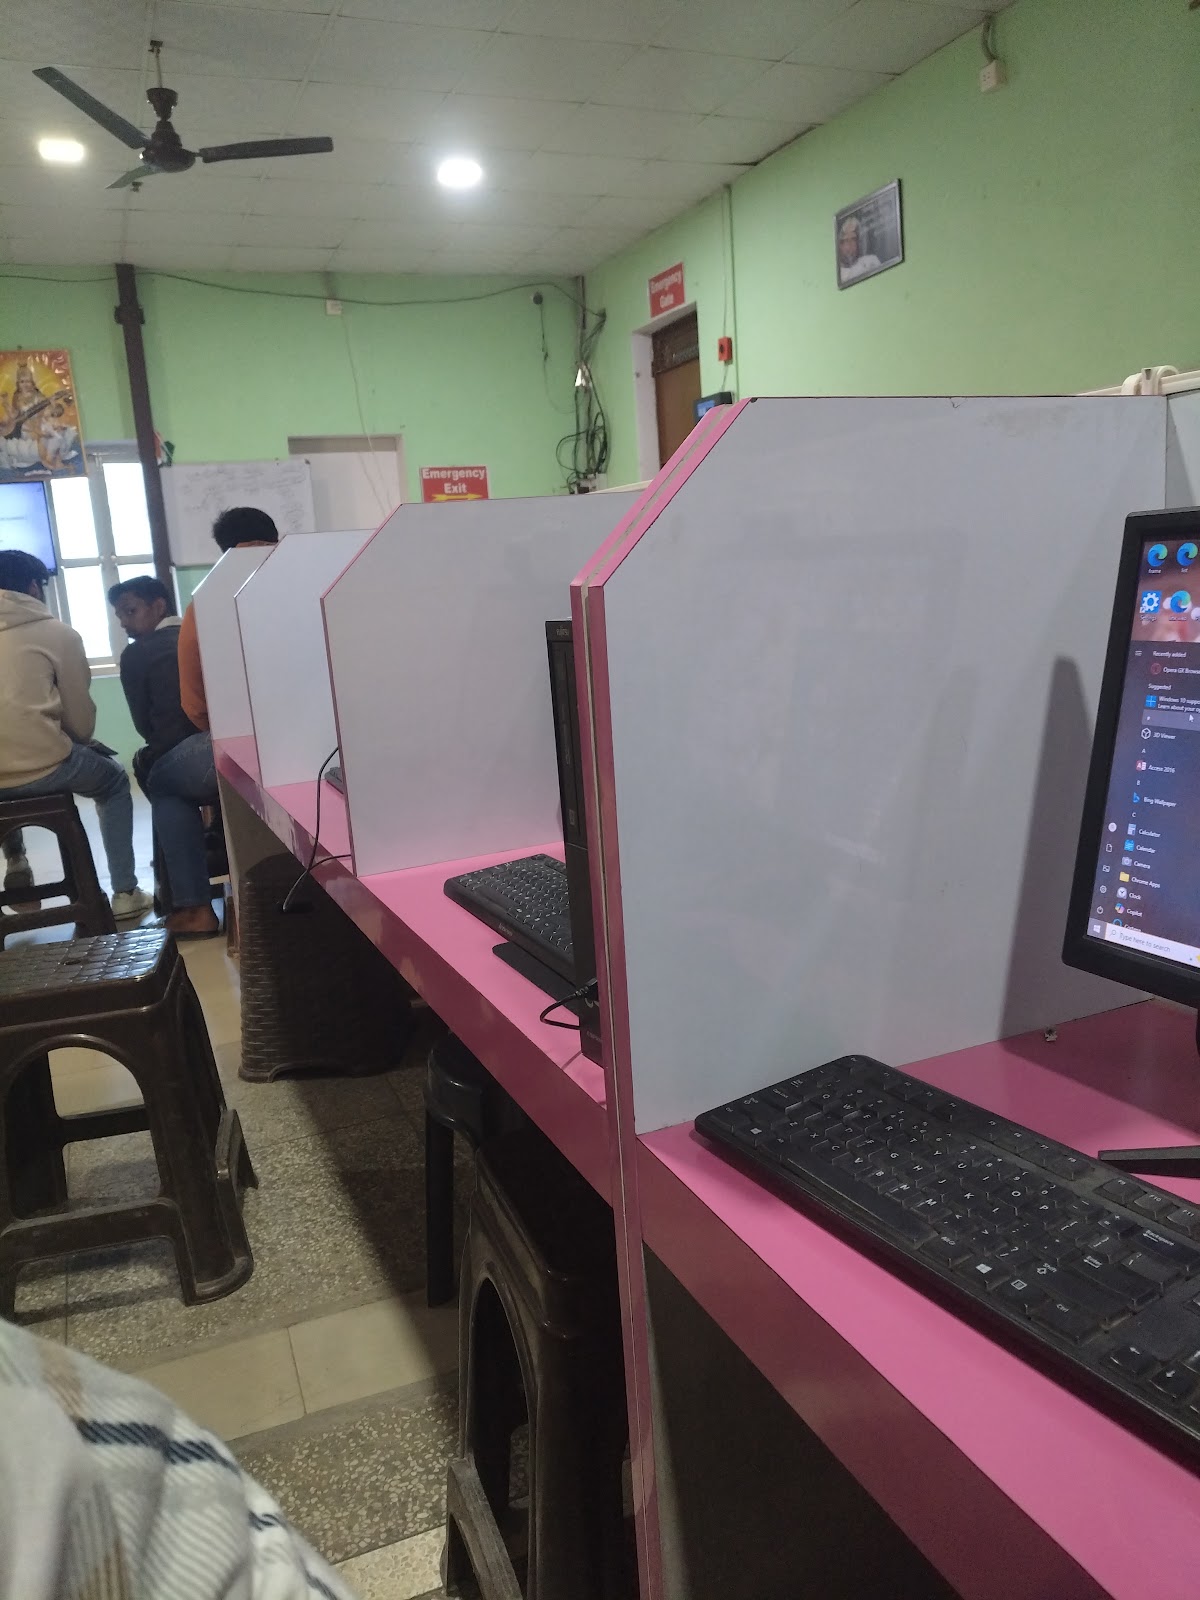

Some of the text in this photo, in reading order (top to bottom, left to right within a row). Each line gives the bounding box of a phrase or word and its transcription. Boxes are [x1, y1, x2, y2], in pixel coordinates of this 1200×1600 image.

[422, 468, 485, 481] Emergency
[444, 483, 468, 494] Exit
[1152, 650, 1171, 659] Recently
[1148, 683, 1172, 691] Suggested
[1144, 796, 1177, 808] Bing Wallpaper
[1138, 828, 1161, 838] Calculator
[1136, 844, 1156, 854] Calendar
[1134, 860, 1151, 869] Camera
[1131, 876, 1149, 885] Chrome
[1126, 908, 1143, 917] Copilot
[1120, 932, 1132, 942] Type
[1133, 937, 1145, 945] here
[1153, 944, 1171, 952] search
[964, 1192, 975, 1200] K
[925, 1198, 938, 1206] M
[1145, 1230, 1175, 1246] Backspace
[1056, 1304, 1070, 1313] Ctrl
